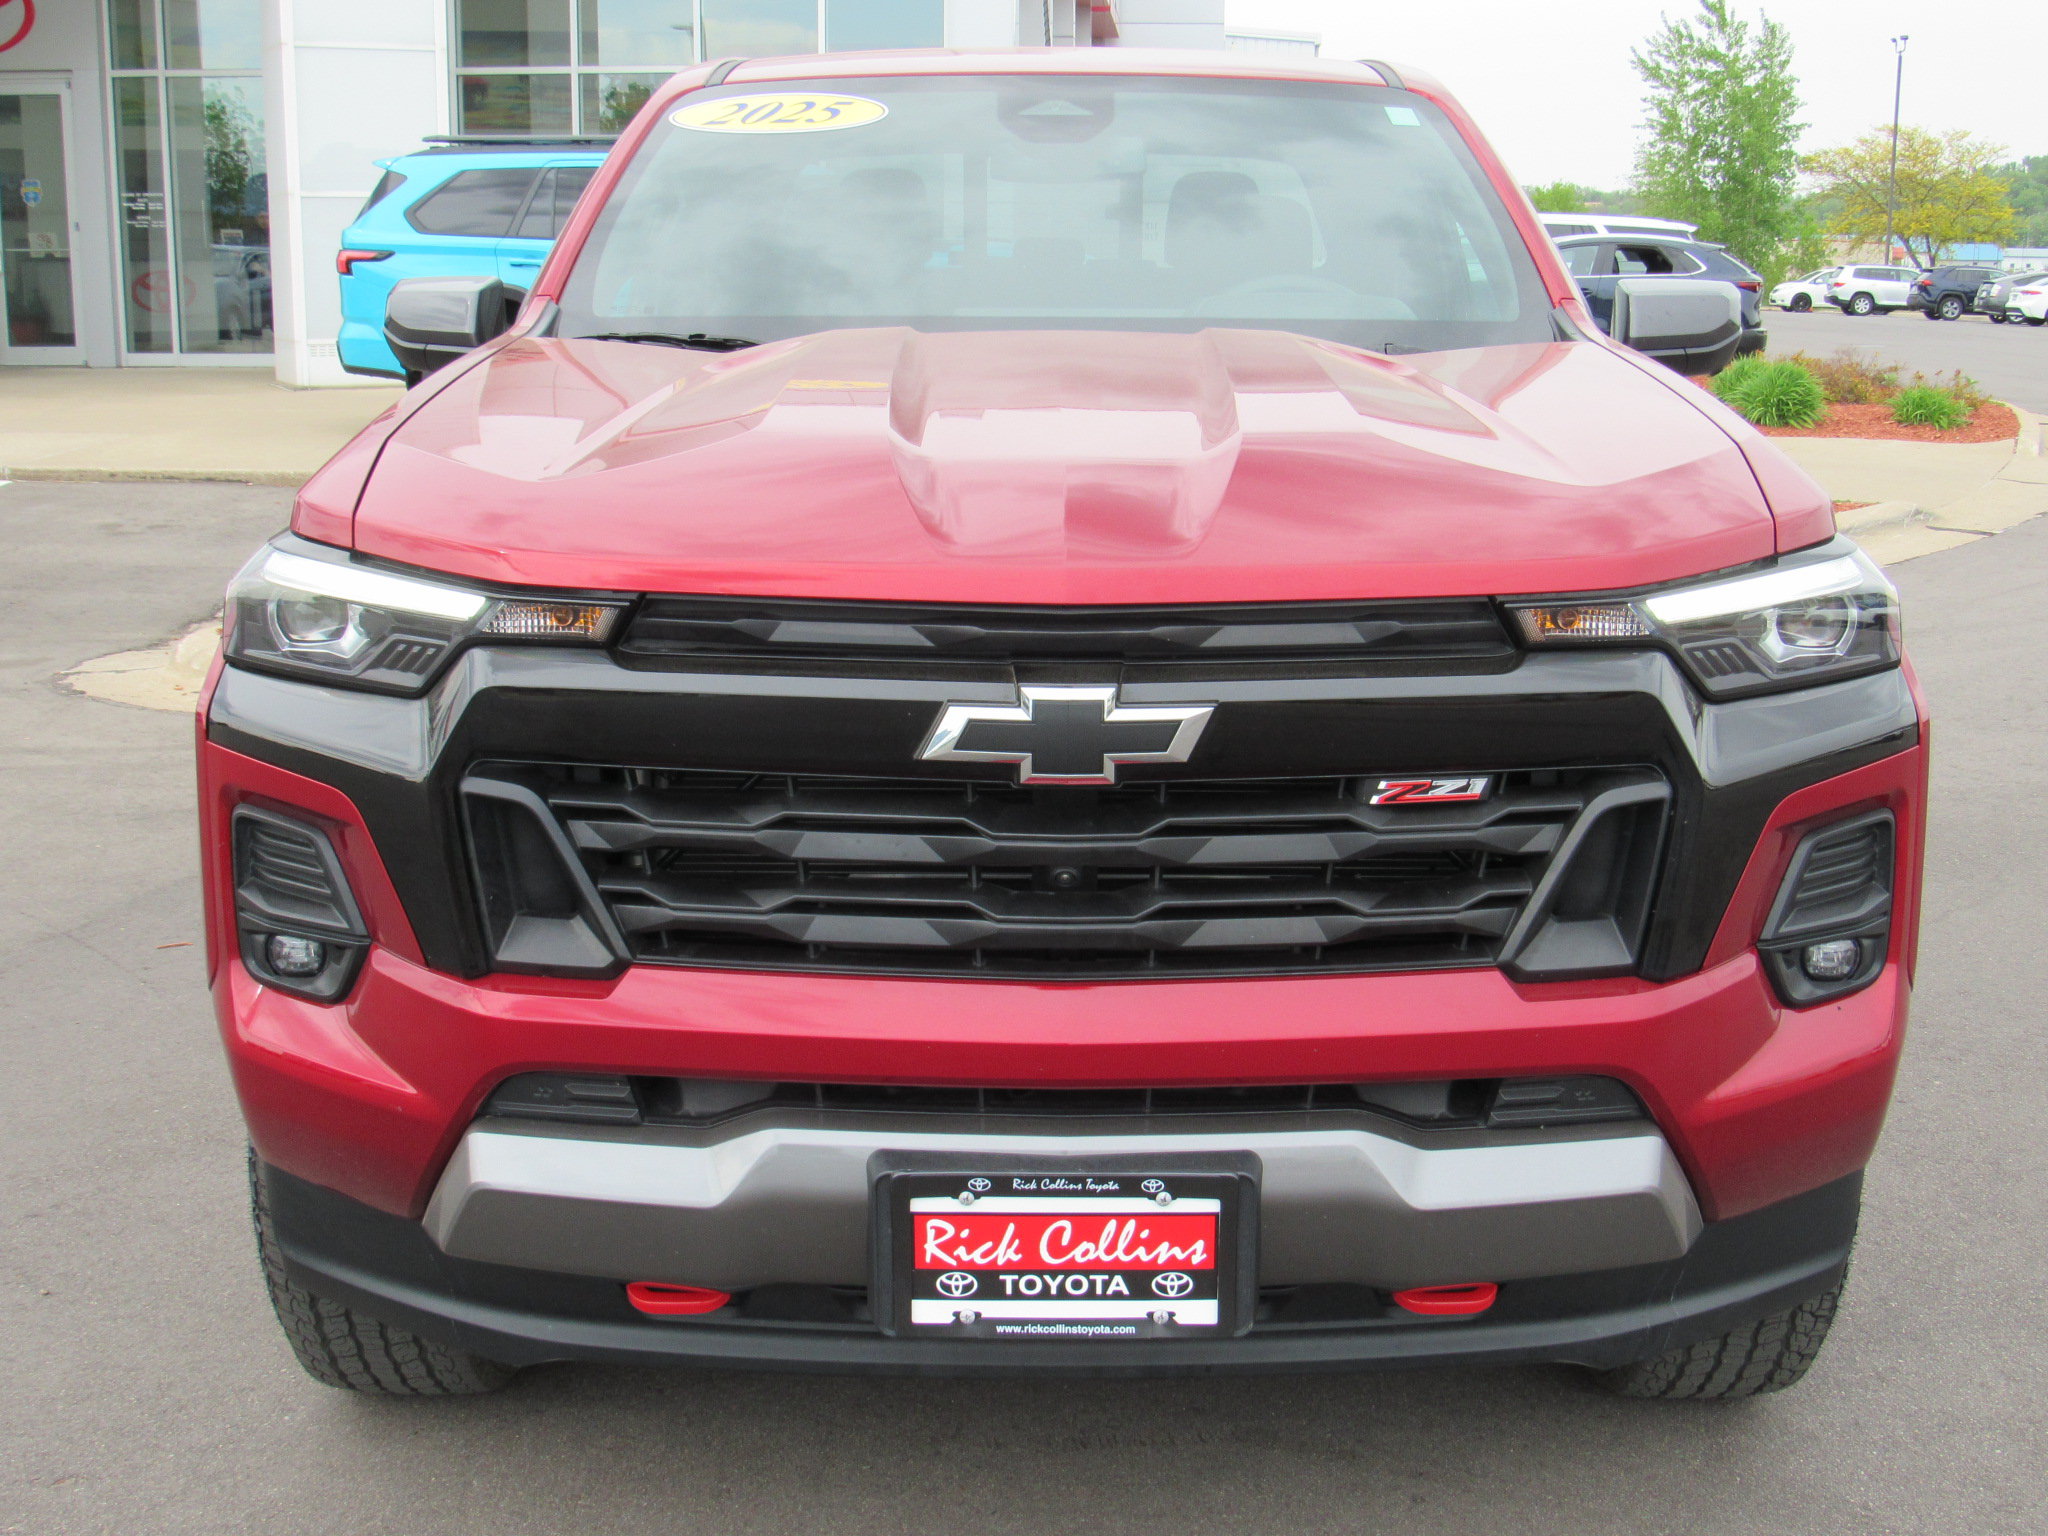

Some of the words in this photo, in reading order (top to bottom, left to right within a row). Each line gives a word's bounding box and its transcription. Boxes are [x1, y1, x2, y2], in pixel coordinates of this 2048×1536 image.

[703, 101, 855, 126] 2025
[1369, 777, 1489, 805] Z71
[1013, 1178, 1037, 1190] Rick
[1040, 1179, 1082, 1190] Collins
[1085, 1179, 1120, 1193] Toyota
[924, 1218, 1022, 1266] Rick
[1039, 1219, 1208, 1265] Collins
[999, 1274, 1130, 1296] TOYOTA
[995, 1323, 1136, 1336] www.rickcollinstoyota.com
